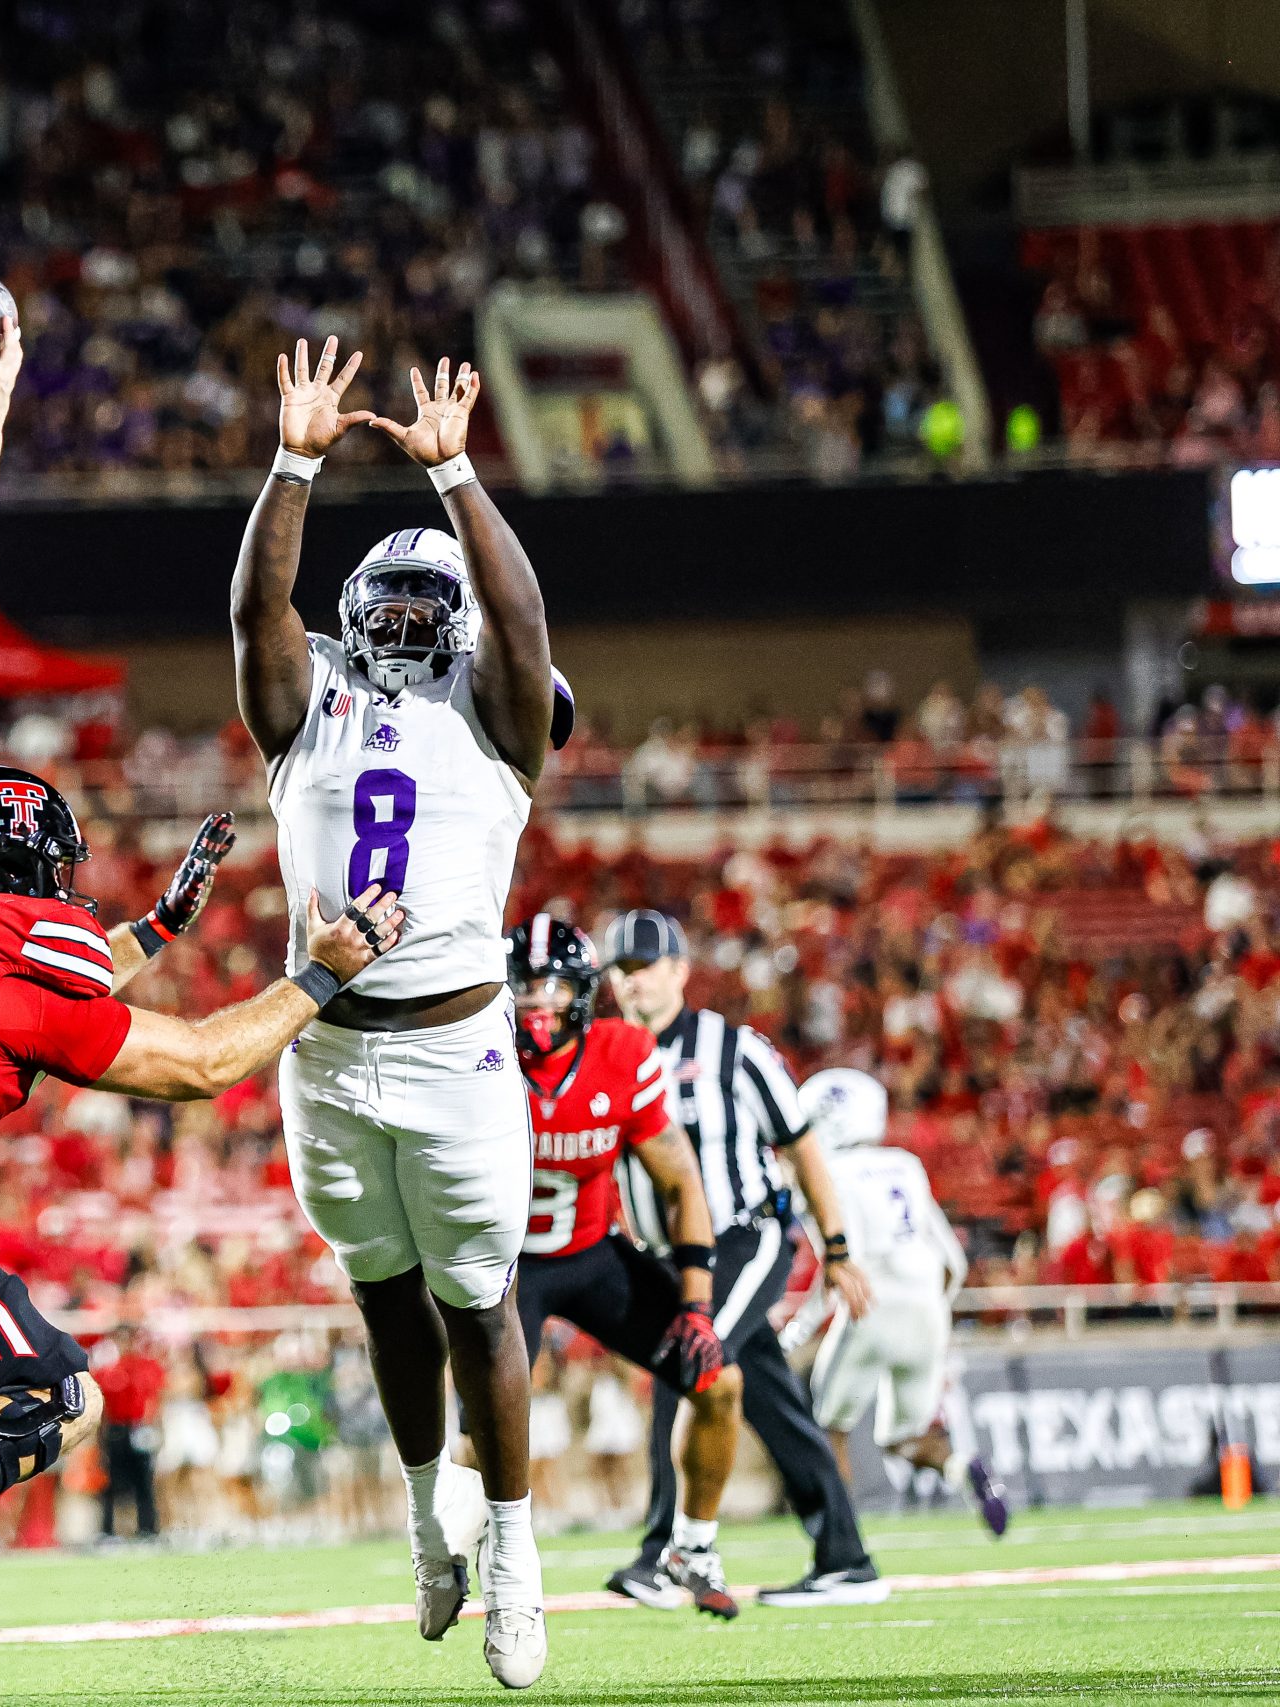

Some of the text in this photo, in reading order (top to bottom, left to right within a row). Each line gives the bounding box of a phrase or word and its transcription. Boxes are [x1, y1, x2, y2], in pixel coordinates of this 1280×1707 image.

[365, 733, 401, 752] ACU
[348, 768, 417, 907] 8
[475, 1059, 504, 1071] ACU
[972, 1385, 1210, 1473] TEXAS
